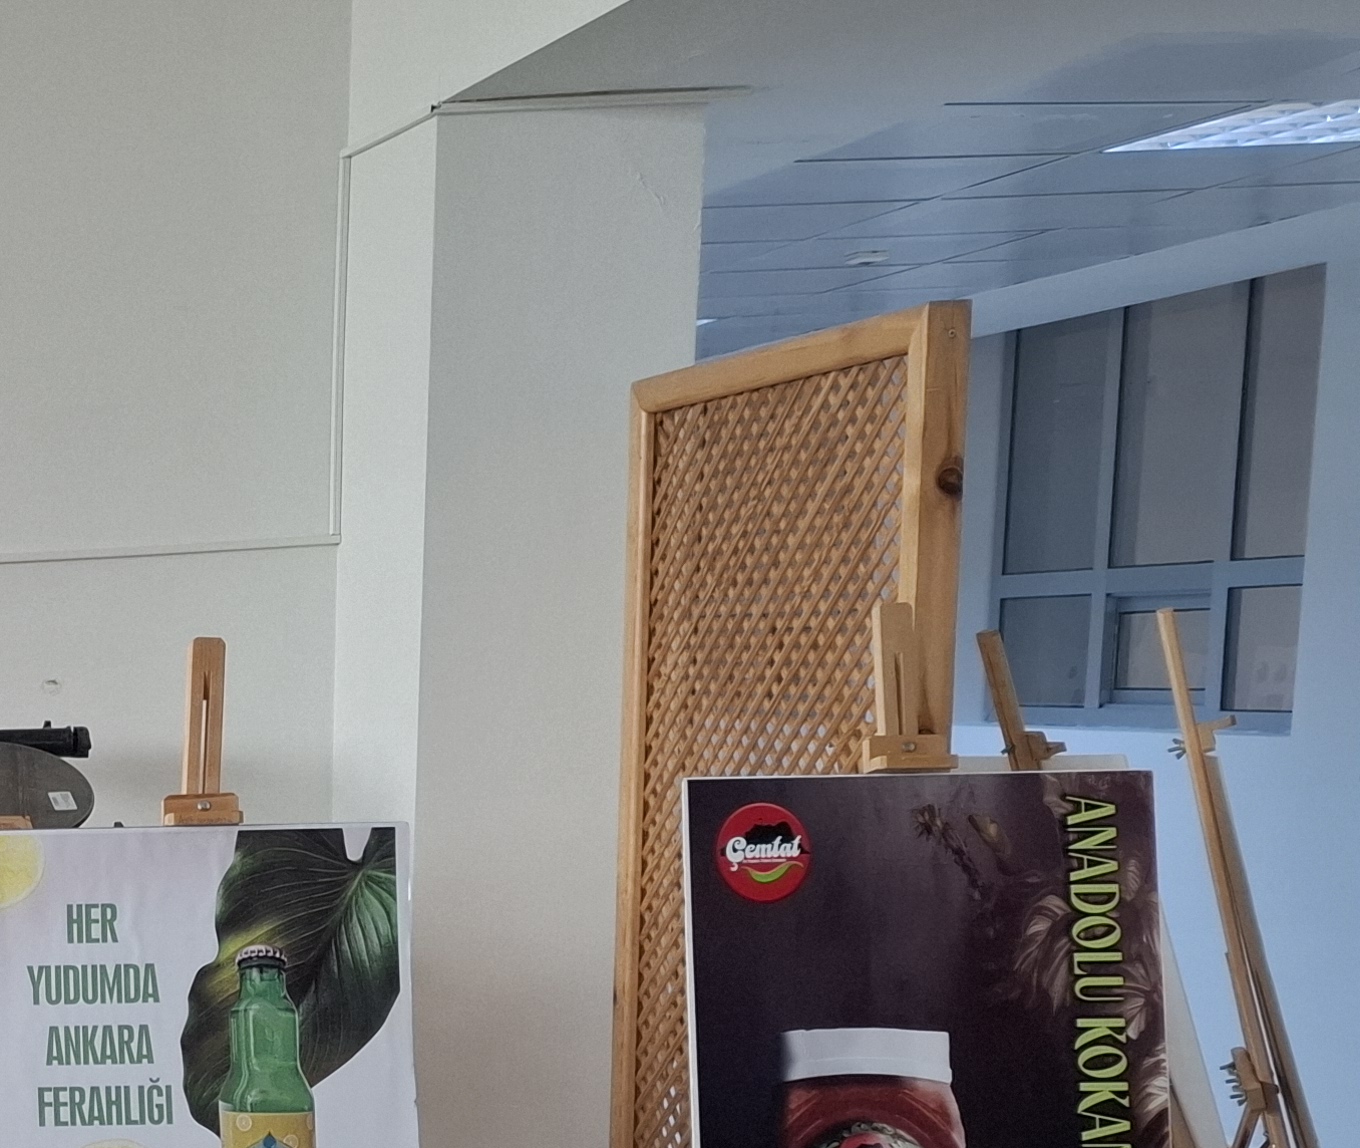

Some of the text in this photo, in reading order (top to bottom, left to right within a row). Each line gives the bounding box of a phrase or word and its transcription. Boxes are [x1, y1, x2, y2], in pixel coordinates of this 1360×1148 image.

[1065, 796, 1125, 1001] ANADOLU
[66, 903, 119, 944] HER
[26, 963, 161, 1005] YUDUMDA
[45, 1024, 155, 1067] ANKARA
[37, 1077, 174, 1127] FERAHLIĞI
